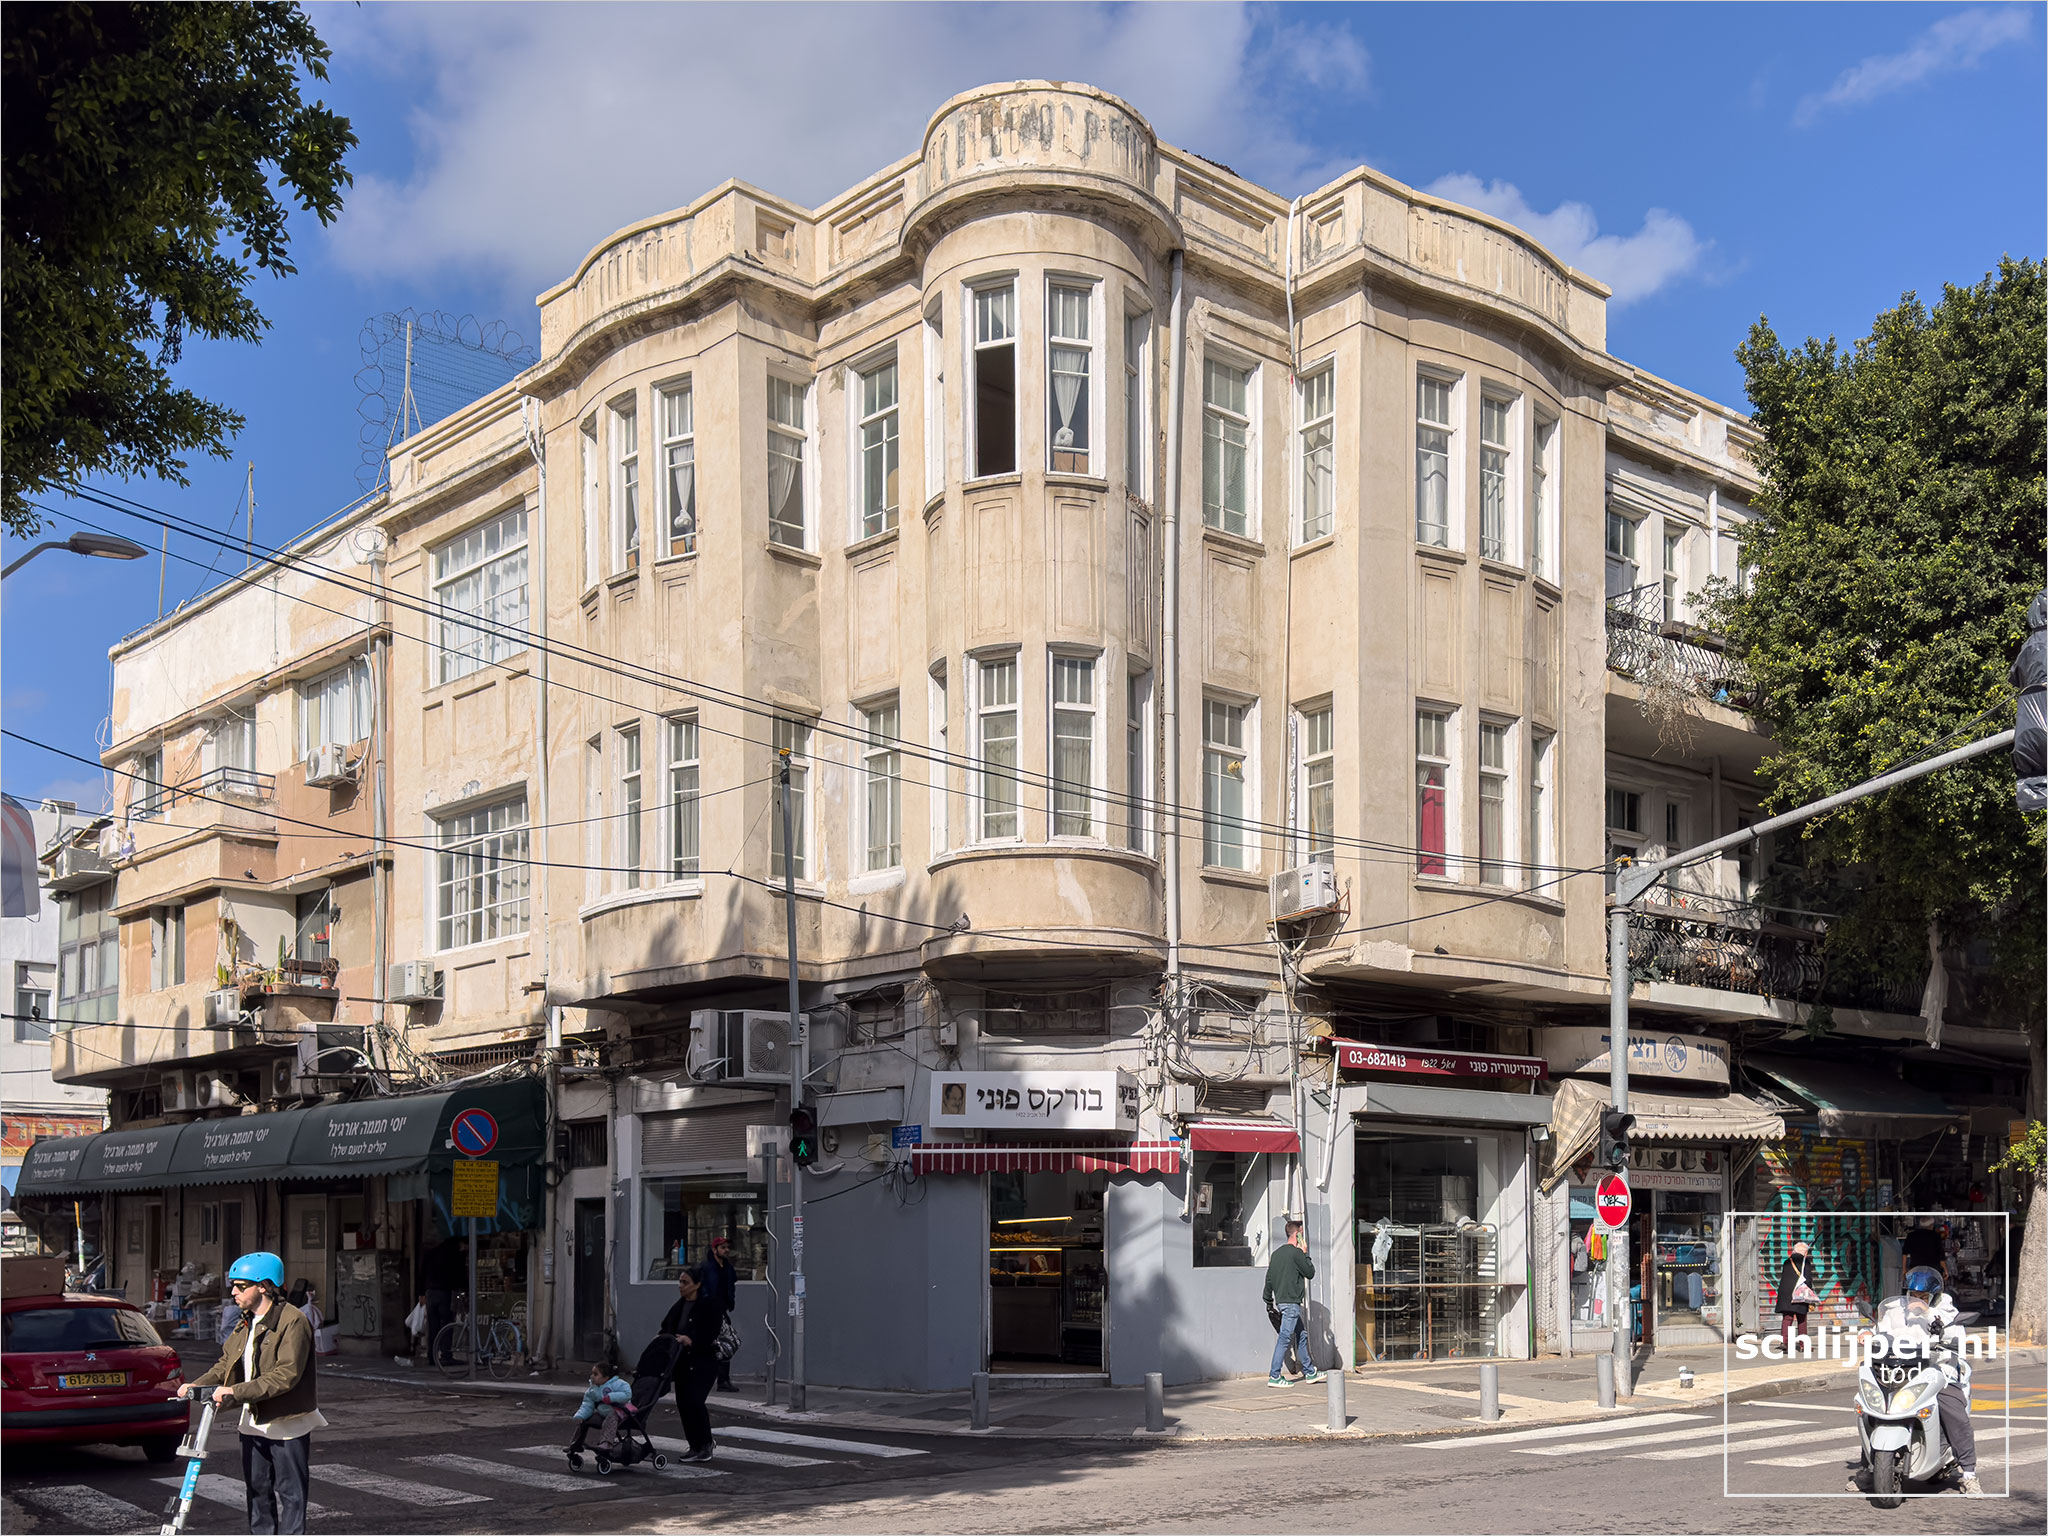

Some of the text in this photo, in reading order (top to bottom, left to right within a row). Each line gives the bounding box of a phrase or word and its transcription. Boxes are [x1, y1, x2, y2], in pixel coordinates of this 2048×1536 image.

[1349, 1050, 1406, 1067] 03-6821413
[1421, 1058, 1438, 1068] 1922
[1490, 1062, 1541, 1078] קונדיטוריה
[1027, 1088, 1103, 1117] בורקס
[328, 1117, 407, 1137] יוסי חממה אורגינל
[204, 1128, 269, 1148] יוסי חממה אורגינל
[330, 1143, 348, 1159] שלך!
[348, 1141, 367, 1155] לטעם
[219, 1150, 235, 1163] לטעם
[1642, 1173, 1662, 1186] לתיקון
[1664, 1175, 1686, 1185] המרכז
[1687, 1176, 1705, 1186] הציוד
[1706, 1178, 1721, 1189] מקור
